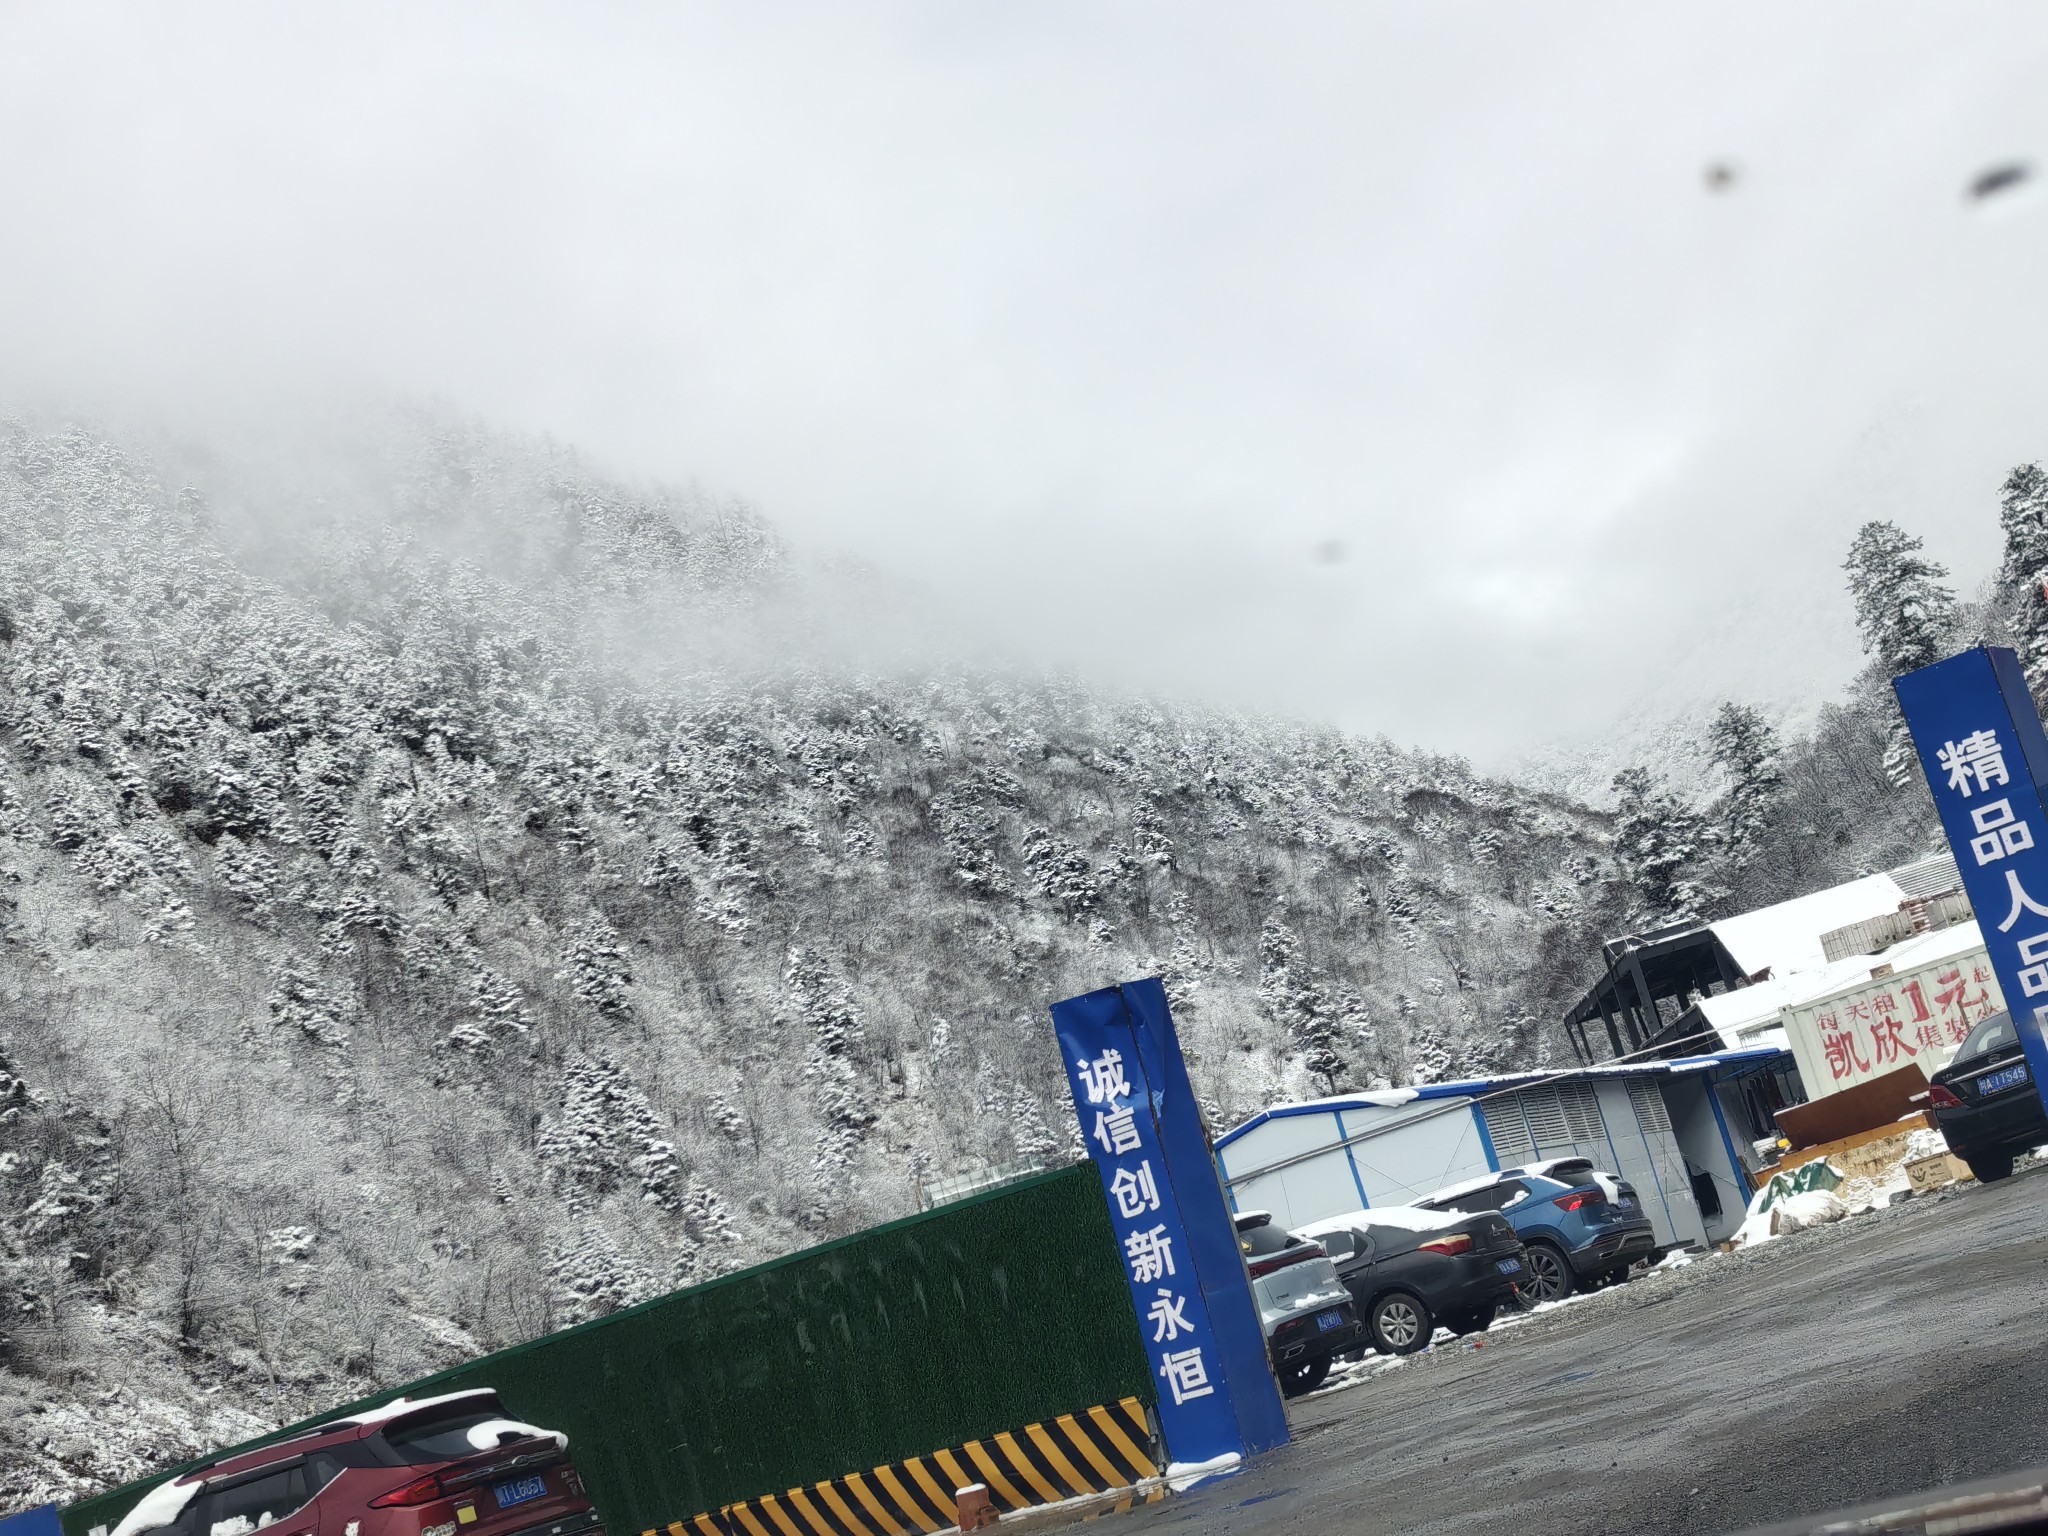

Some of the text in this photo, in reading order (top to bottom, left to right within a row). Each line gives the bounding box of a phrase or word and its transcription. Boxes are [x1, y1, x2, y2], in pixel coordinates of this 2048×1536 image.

[1077, 1049, 1214, 1406] 诚信创新永恒
